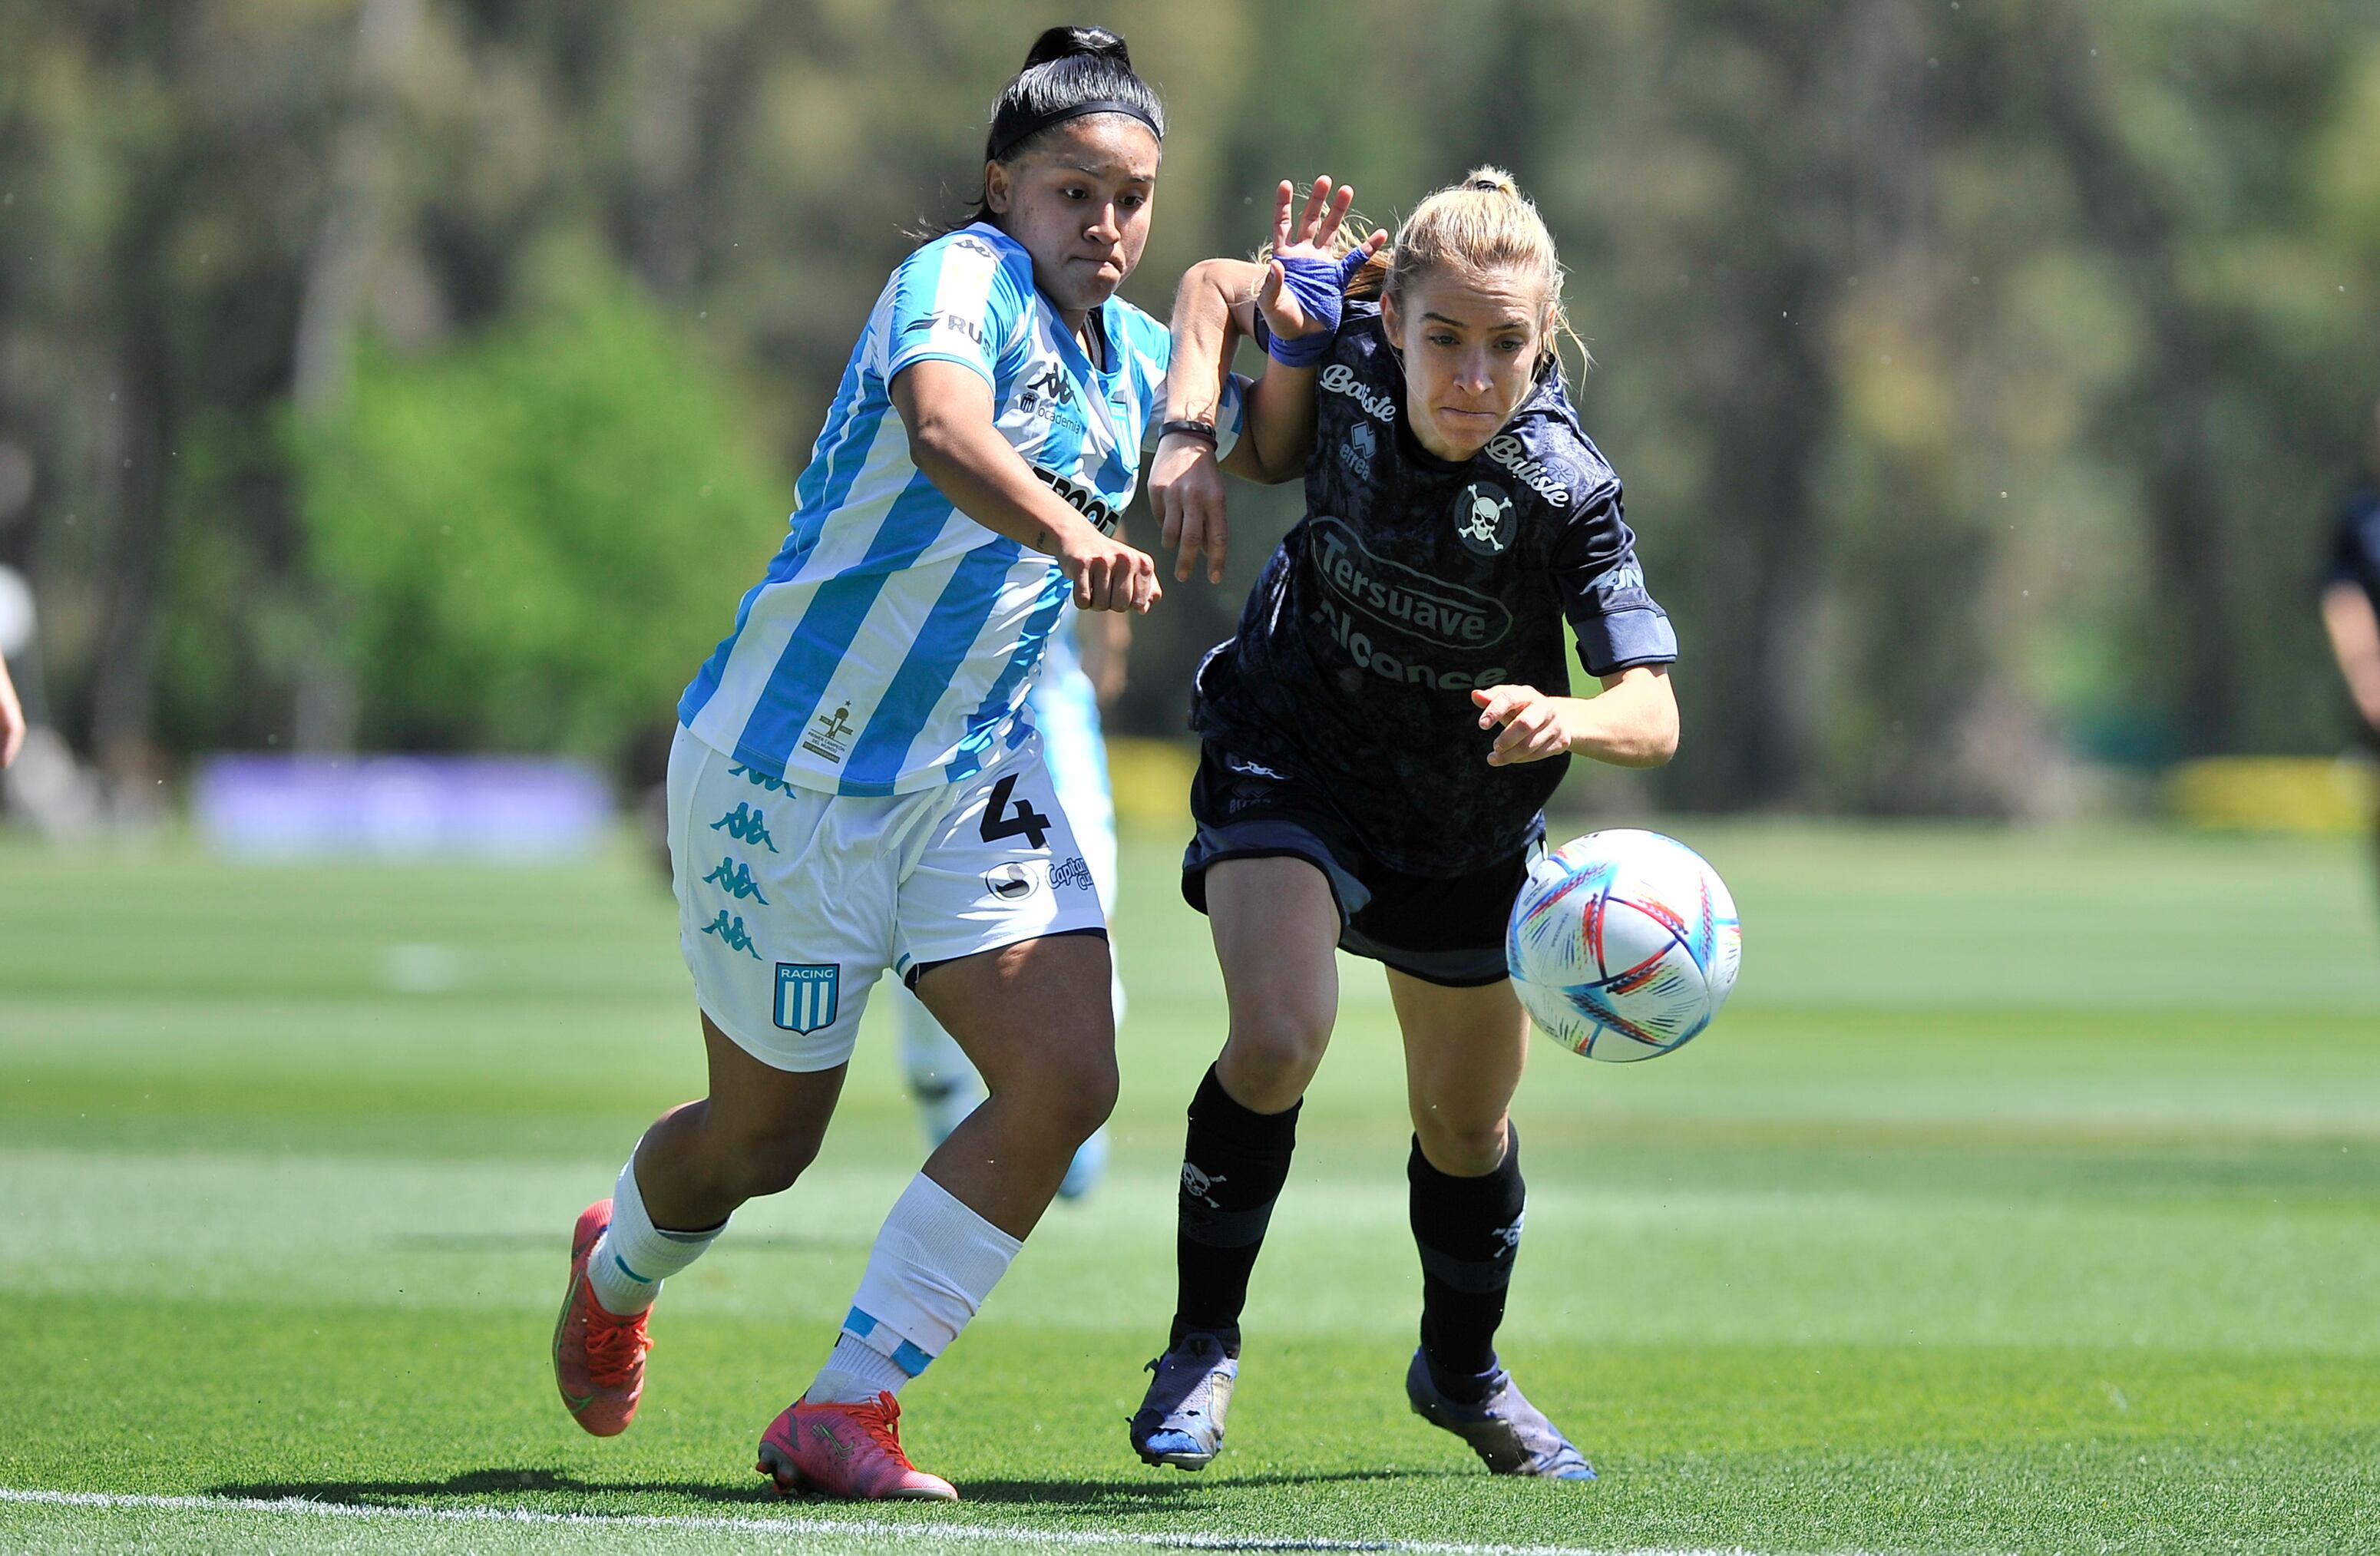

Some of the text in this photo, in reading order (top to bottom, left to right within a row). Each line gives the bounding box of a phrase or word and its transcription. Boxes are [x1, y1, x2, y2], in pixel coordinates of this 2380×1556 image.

[948, 315, 991, 358] RUS
[1483, 434, 1569, 507] Batiste
[1322, 530, 1486, 640] Tersuave
[979, 772, 1052, 850] 4
[781, 969, 834, 979] RACING
